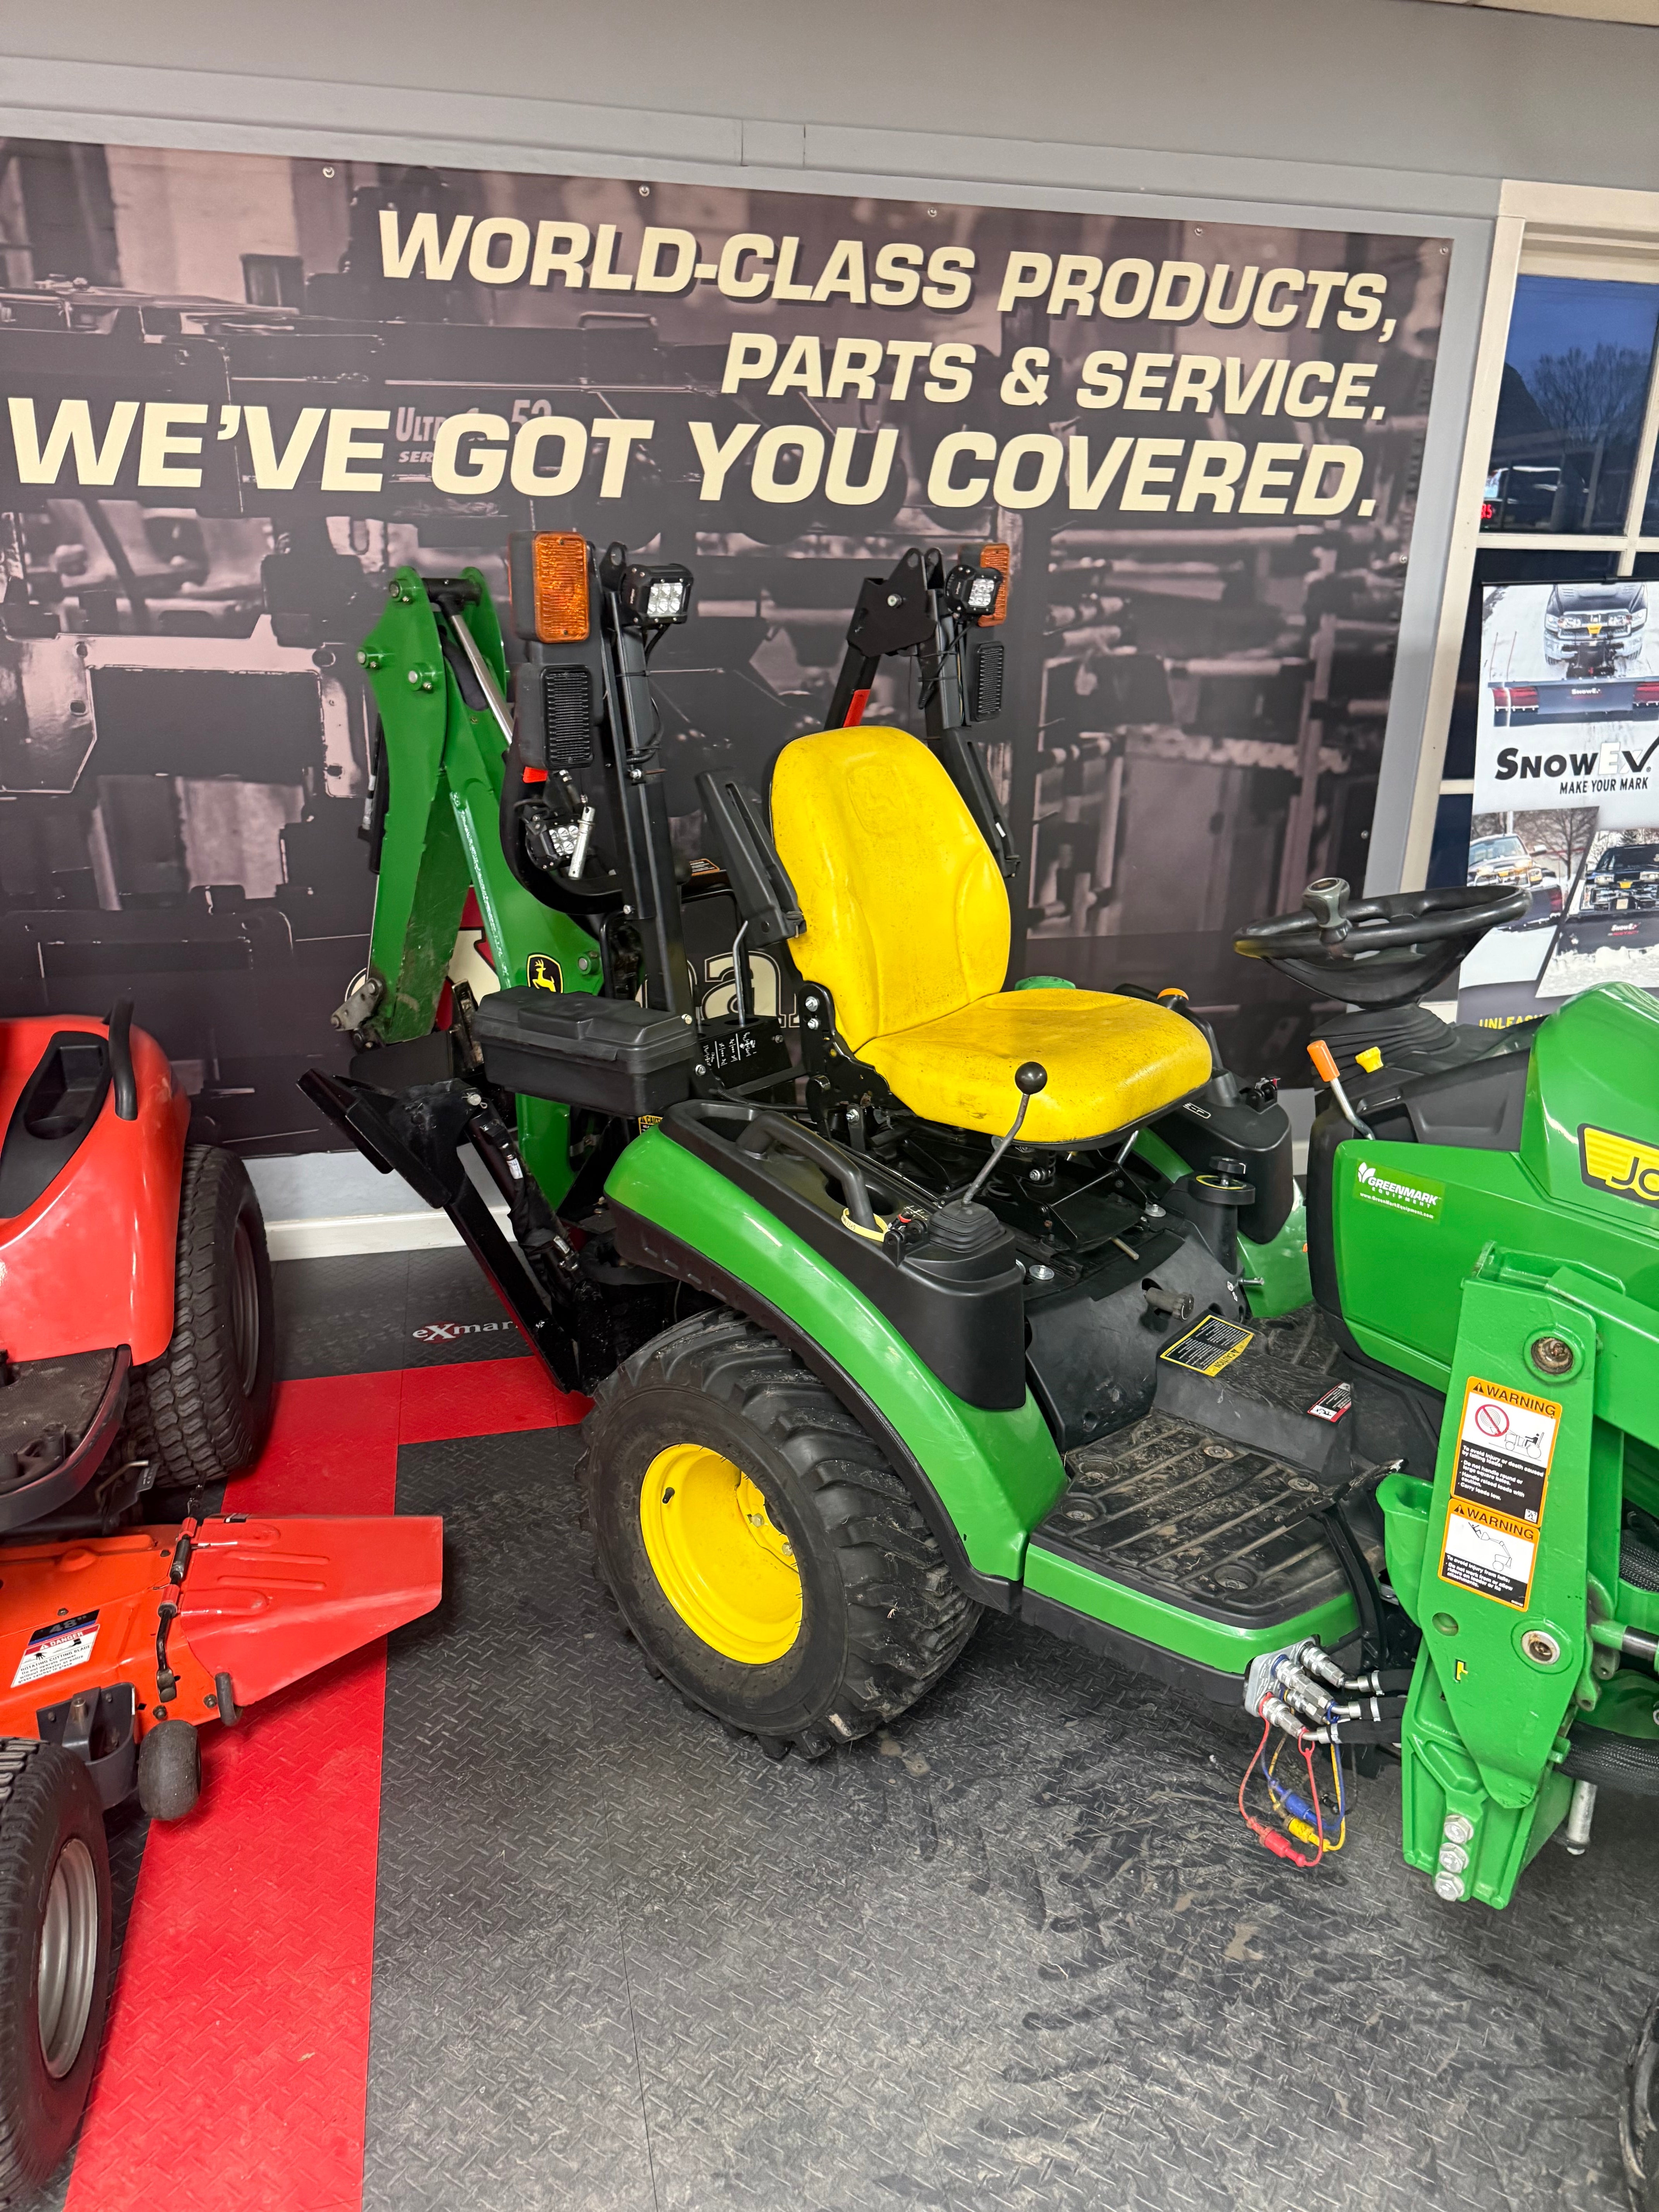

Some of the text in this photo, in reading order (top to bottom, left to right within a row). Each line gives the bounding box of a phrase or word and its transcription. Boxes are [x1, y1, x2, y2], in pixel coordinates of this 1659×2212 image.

[380, 211, 1396, 342] WORLD-CLASS PRODUCTS,
[721, 333, 1385, 419] PARTS & SERVICE.
[8, 398, 389, 491] WE'VE
[432, 413, 653, 497] GOT
[689, 422, 898, 505] YOU
[928, 432, 1375, 516] COVERED.
[398, 451, 434, 463] SER
[1559, 777, 1649, 794] MAKE YOUR MARK
[1368, 1177, 1438, 1206] GREENMARK
[1372, 1187, 1430, 1208] EQUIPMENT
[412, 1321, 518, 1341] eXmar
[1214, 1351, 1236, 1369] CAUTION
[1487, 1384, 1556, 1416] WARNING
[1470, 1448, 1484, 1456] avoid
[1486, 1453, 1501, 1463] injury
[1508, 1461, 1523, 1470] death
[1524, 1467, 1544, 1477] caused
[1462, 1472, 1480, 1481] Handle
[1481, 1478, 1497, 1487] raised
[1498, 1484, 1512, 1493] loads
[1482, 1466, 1499, 1476] handle
[1500, 1473, 1516, 1482] round
[1460, 1482, 1474, 1491] Carry
[1476, 1487, 1490, 1496] loads
[1467, 1508, 1534, 1540] WARNING
[1454, 1558, 1468, 1566] avoid
[1469, 1563, 1483, 1573] injury
[1466, 1569, 1479, 1578] work
[1479, 1574, 1491, 1582] from
[1499, 1582, 1513, 1591] allow
[50, 1632, 83, 1646] DANGER
[21, 1659, 48, 1671] ROTATING
[49, 1652, 72, 1661] CUTTING
